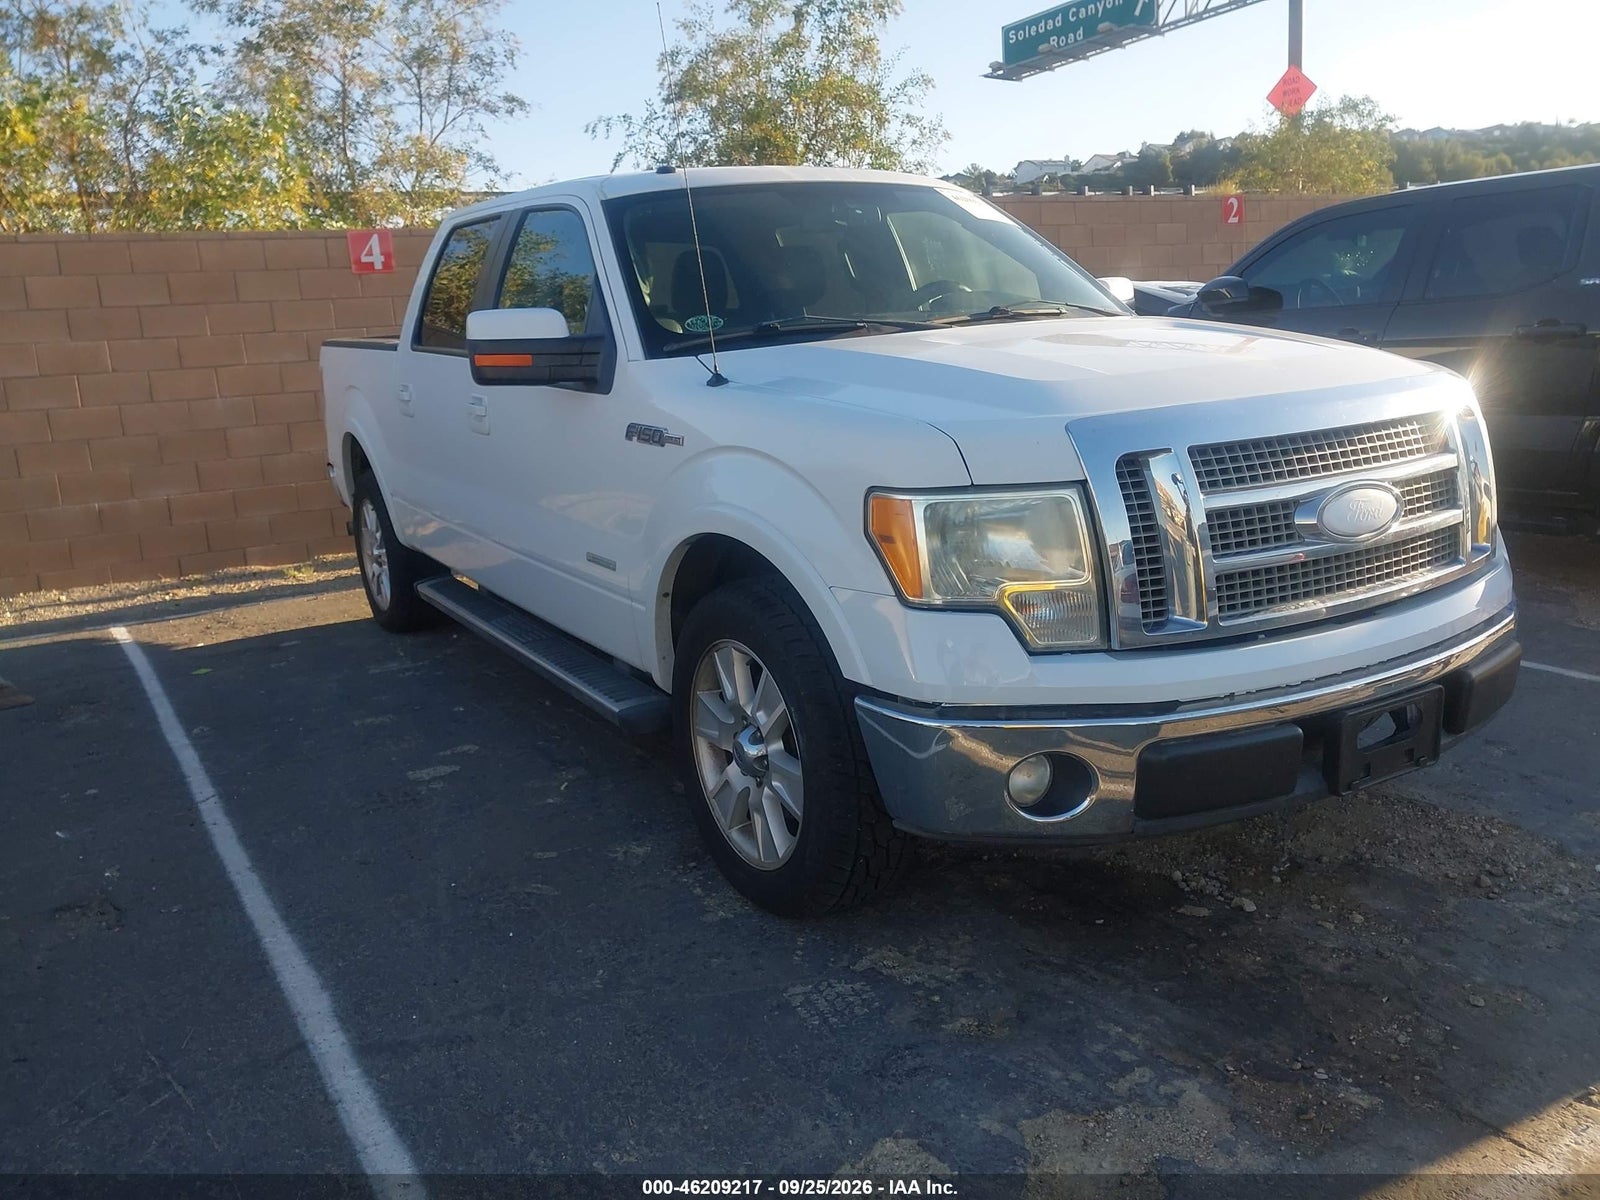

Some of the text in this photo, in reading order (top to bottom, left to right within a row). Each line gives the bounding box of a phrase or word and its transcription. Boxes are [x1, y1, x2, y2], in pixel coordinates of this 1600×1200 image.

[1008, 13, 1063, 44] Soledad
[1050, 27, 1084, 48] Road
[1227, 197, 1239, 224] 2
[360, 233, 385, 270] 4
[1346, 499, 1384, 522] Ford
